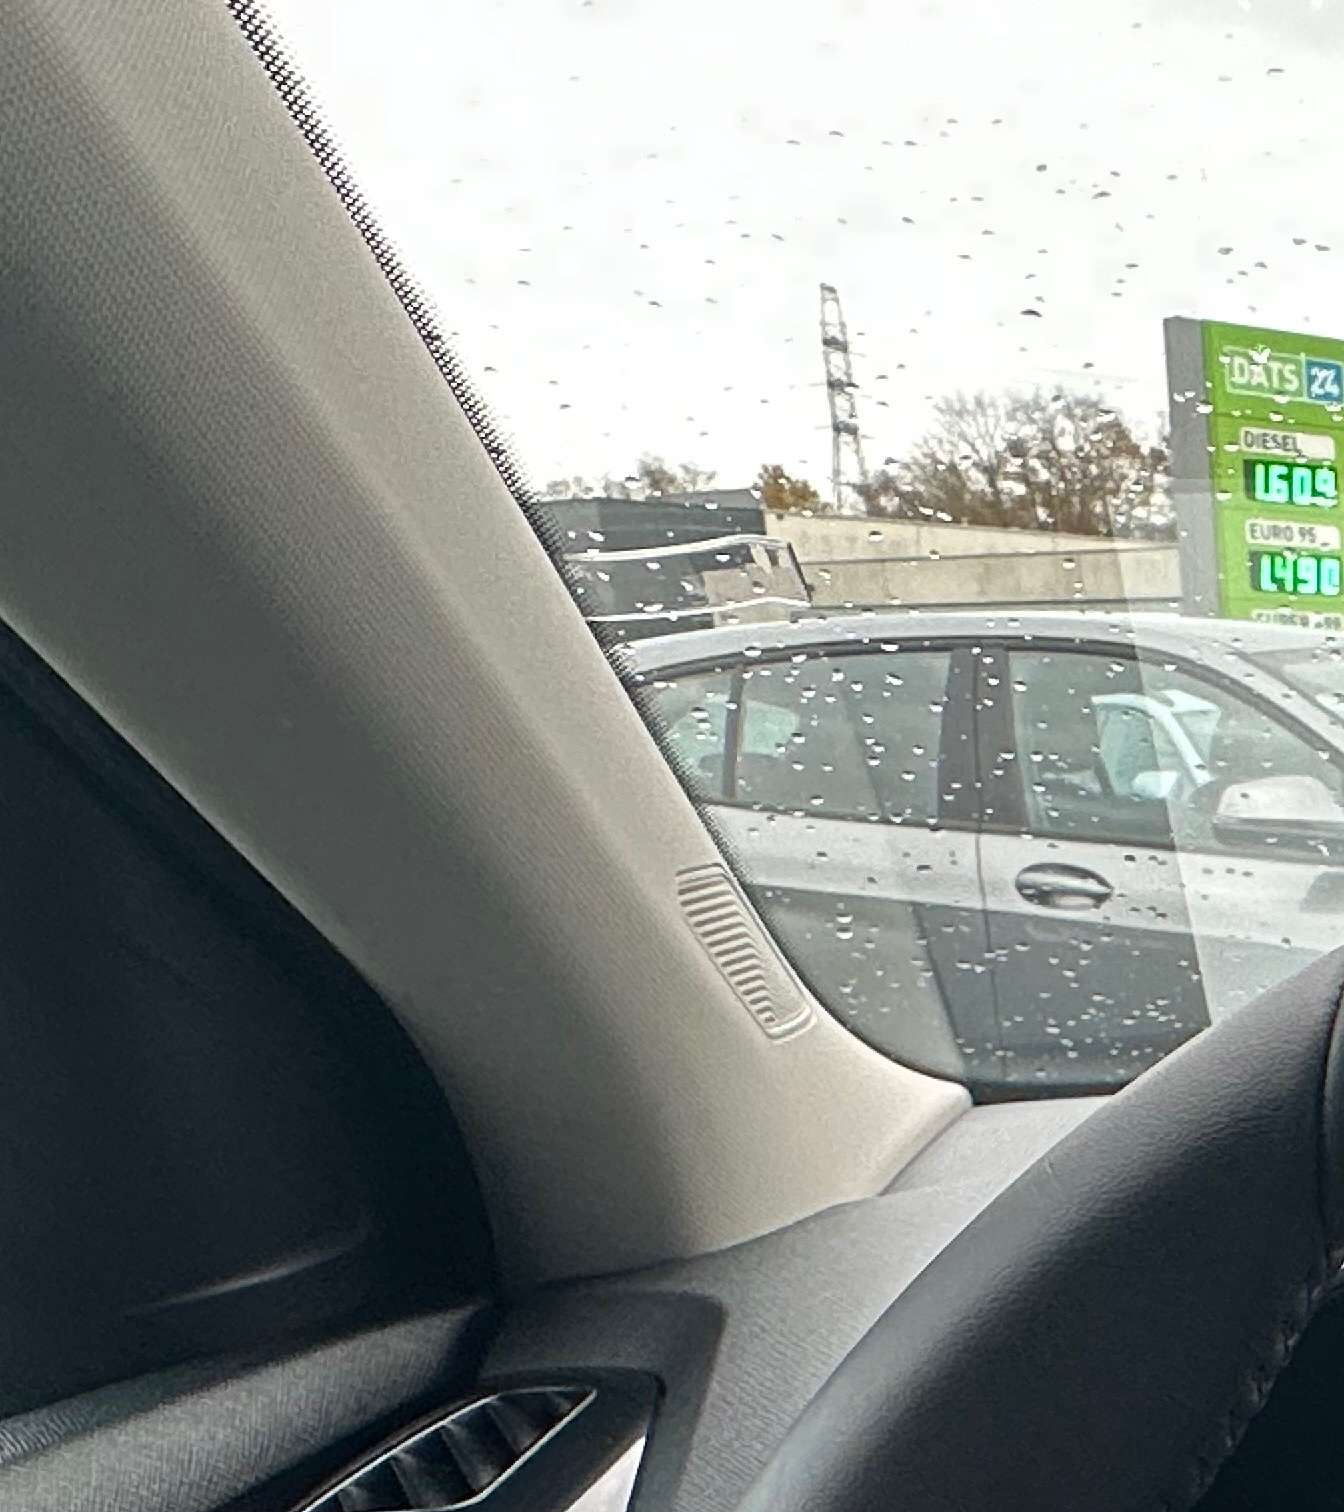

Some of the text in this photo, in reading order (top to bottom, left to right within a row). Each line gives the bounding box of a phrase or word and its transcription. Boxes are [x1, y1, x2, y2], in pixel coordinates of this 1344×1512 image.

[1231, 355, 1299, 391] DATS
[1244, 430, 1299, 452] DIESEL
[1249, 522, 1294, 542] EURO
